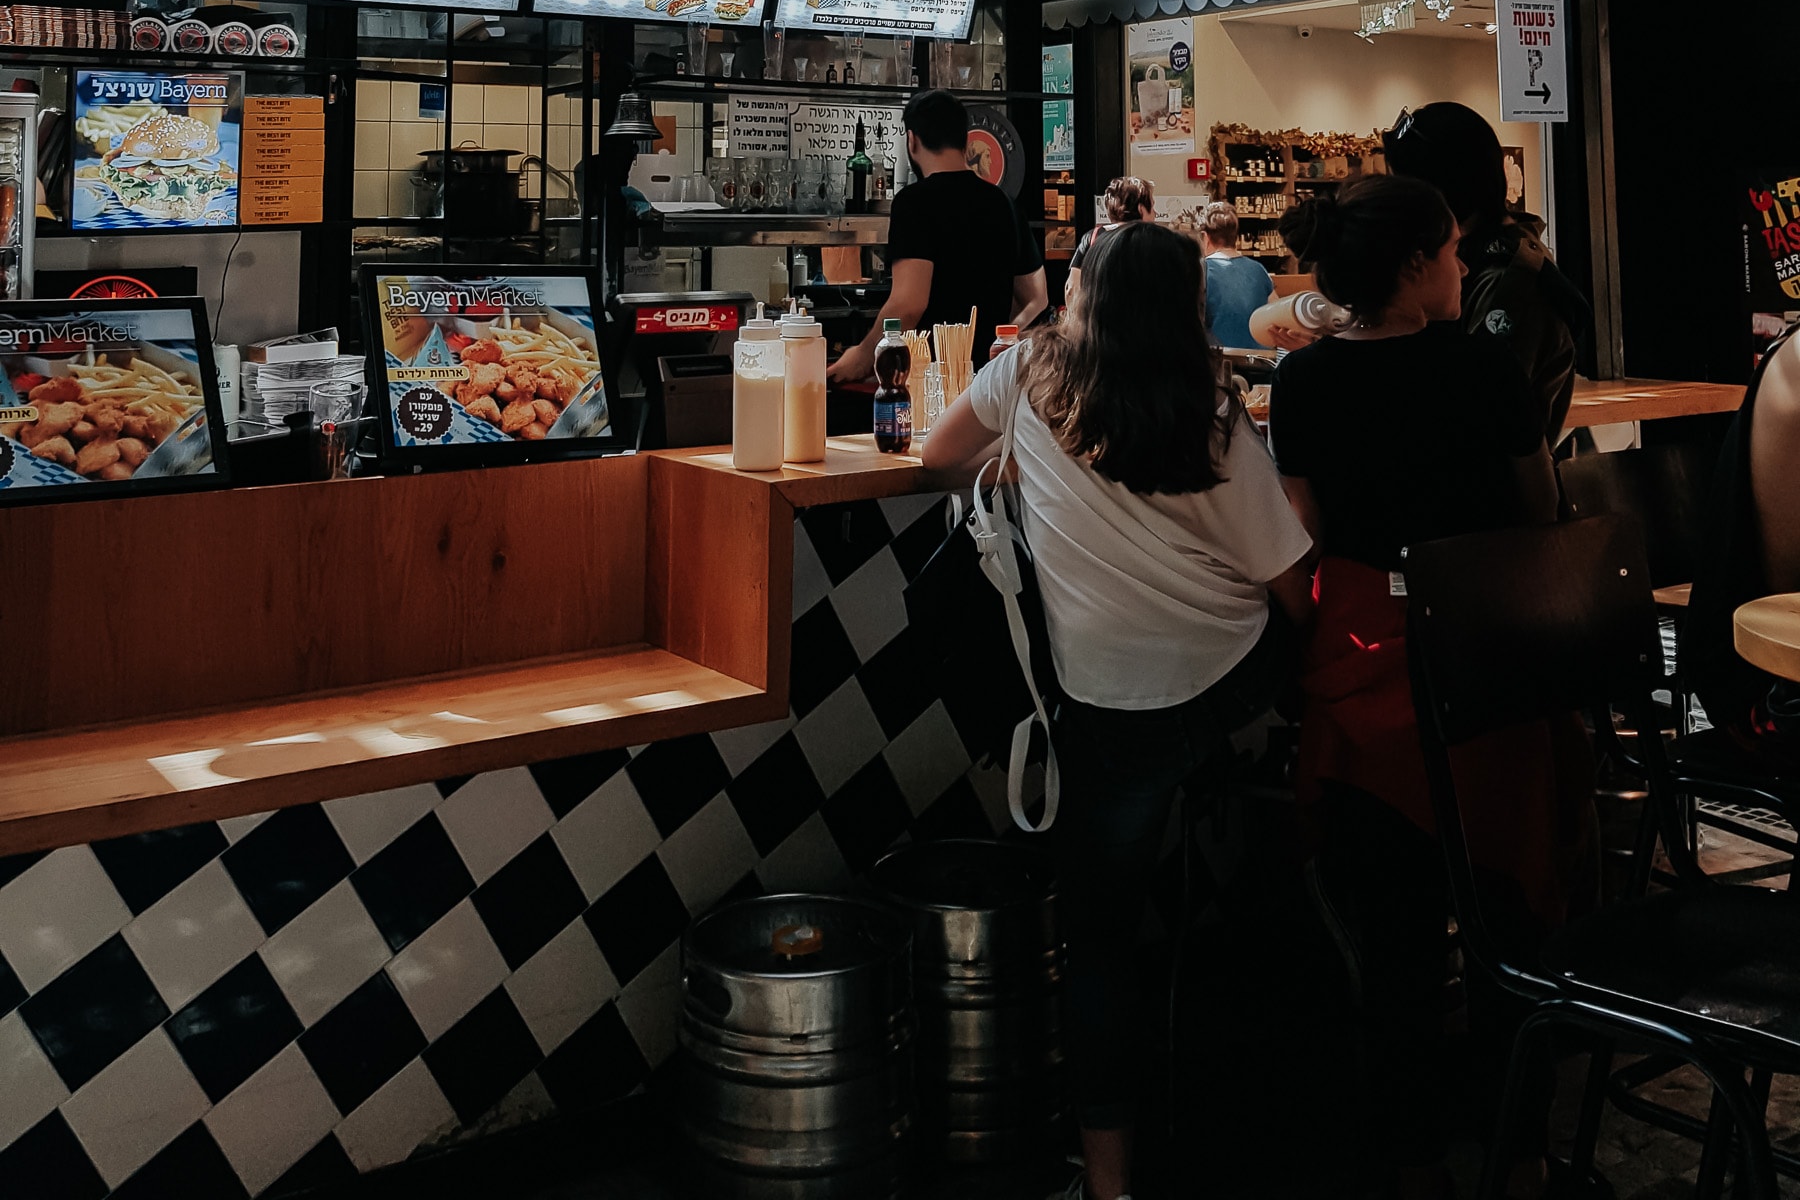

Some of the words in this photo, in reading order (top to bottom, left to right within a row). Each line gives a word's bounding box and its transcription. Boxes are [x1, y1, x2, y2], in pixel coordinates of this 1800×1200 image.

[844, 0, 851, 8] 17
[1513, 11, 1546, 27] שעות
[1548, 12, 1556, 28] 3
[1519, 27, 1551, 46] חינם!
[92, 78, 155, 99] שניצל
[159, 79, 228, 103] Bayern
[736, 100, 749, 109] של
[809, 106, 840, 118] הגשה
[843, 109, 856, 119] או
[859, 109, 893, 121] מכירה
[734, 115, 767, 124] משכרים
[732, 127, 742, 137] לו
[743, 128, 764, 138] מלאו
[794, 121, 839, 135] משכרים
[892, 125, 907, 136] של
[807, 137, 836, 150] מלאו
[840, 140, 873, 151] שרם
[387, 285, 546, 313] BayernMarket
[669, 312, 690, 323] ביס
[692, 311, 706, 323] תן
[396, 369, 427, 380] ילדים
[430, 368, 464, 379] ארוחת
[419, 392, 433, 402] עם
[408, 402, 444, 413] פופקורן
[0, 408, 31, 419] ארוח
[411, 412, 440, 422] שניצל
